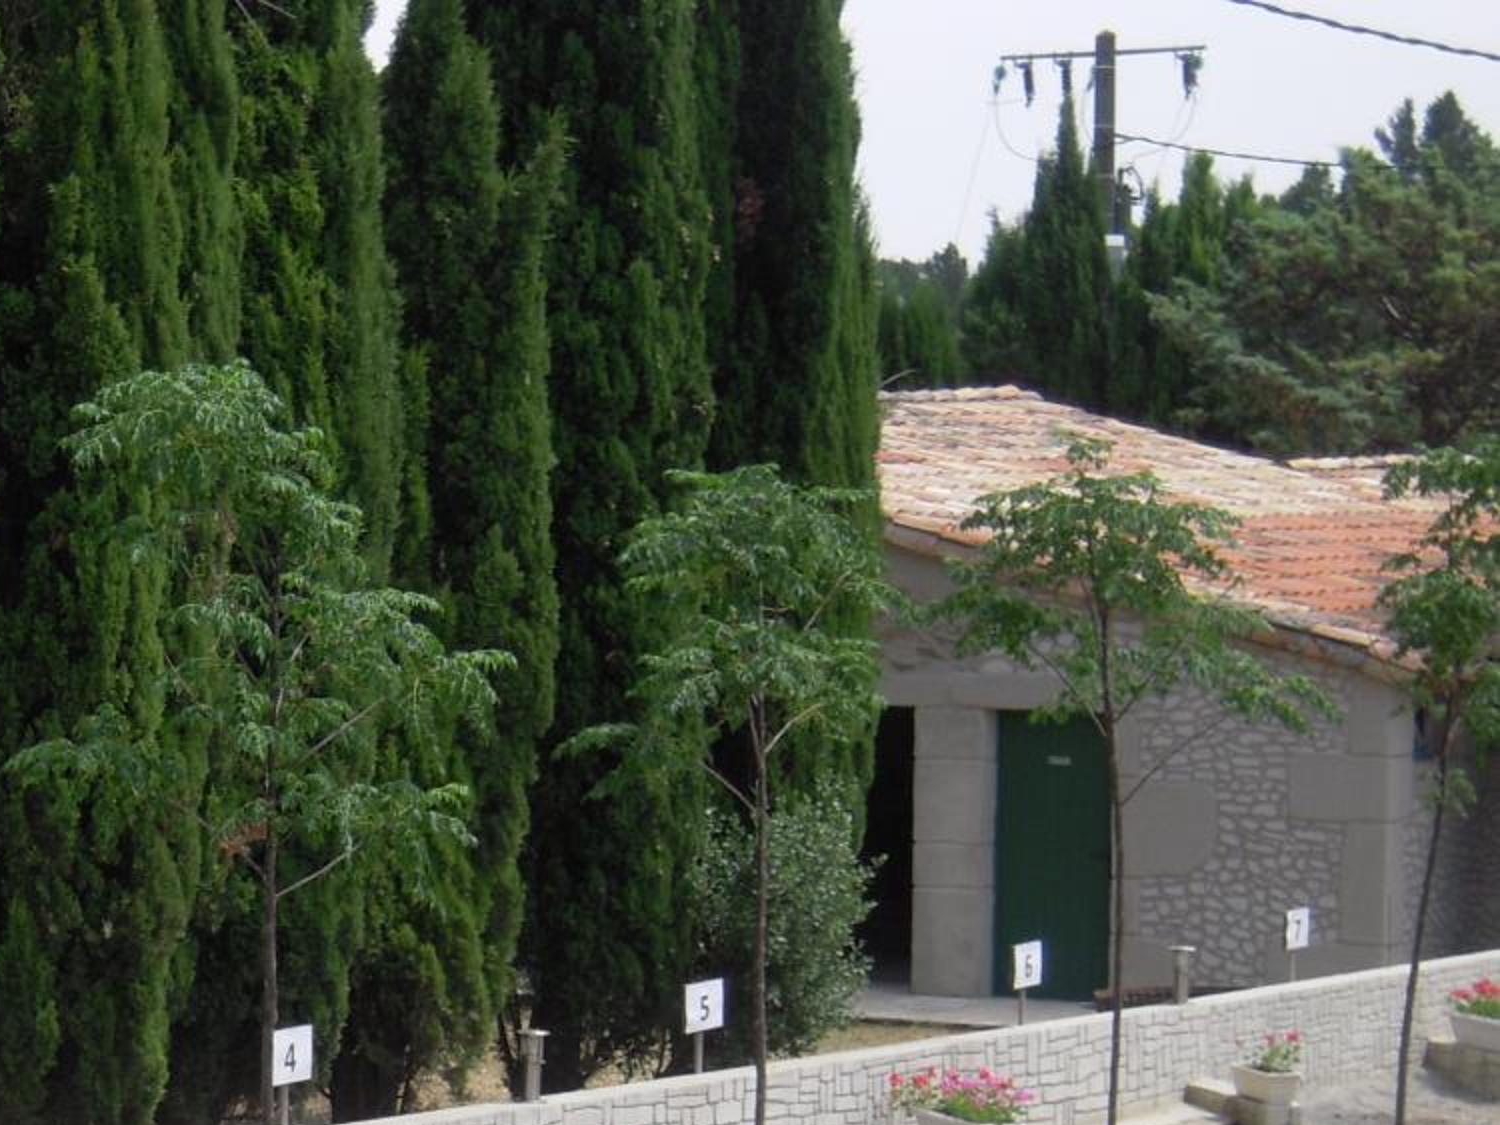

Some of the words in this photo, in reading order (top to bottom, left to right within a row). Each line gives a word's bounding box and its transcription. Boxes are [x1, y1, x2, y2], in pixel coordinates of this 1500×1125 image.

[1023, 954, 1032, 979] 6
[700, 995, 711, 1021] 5
[284, 1043, 297, 1073] 4
